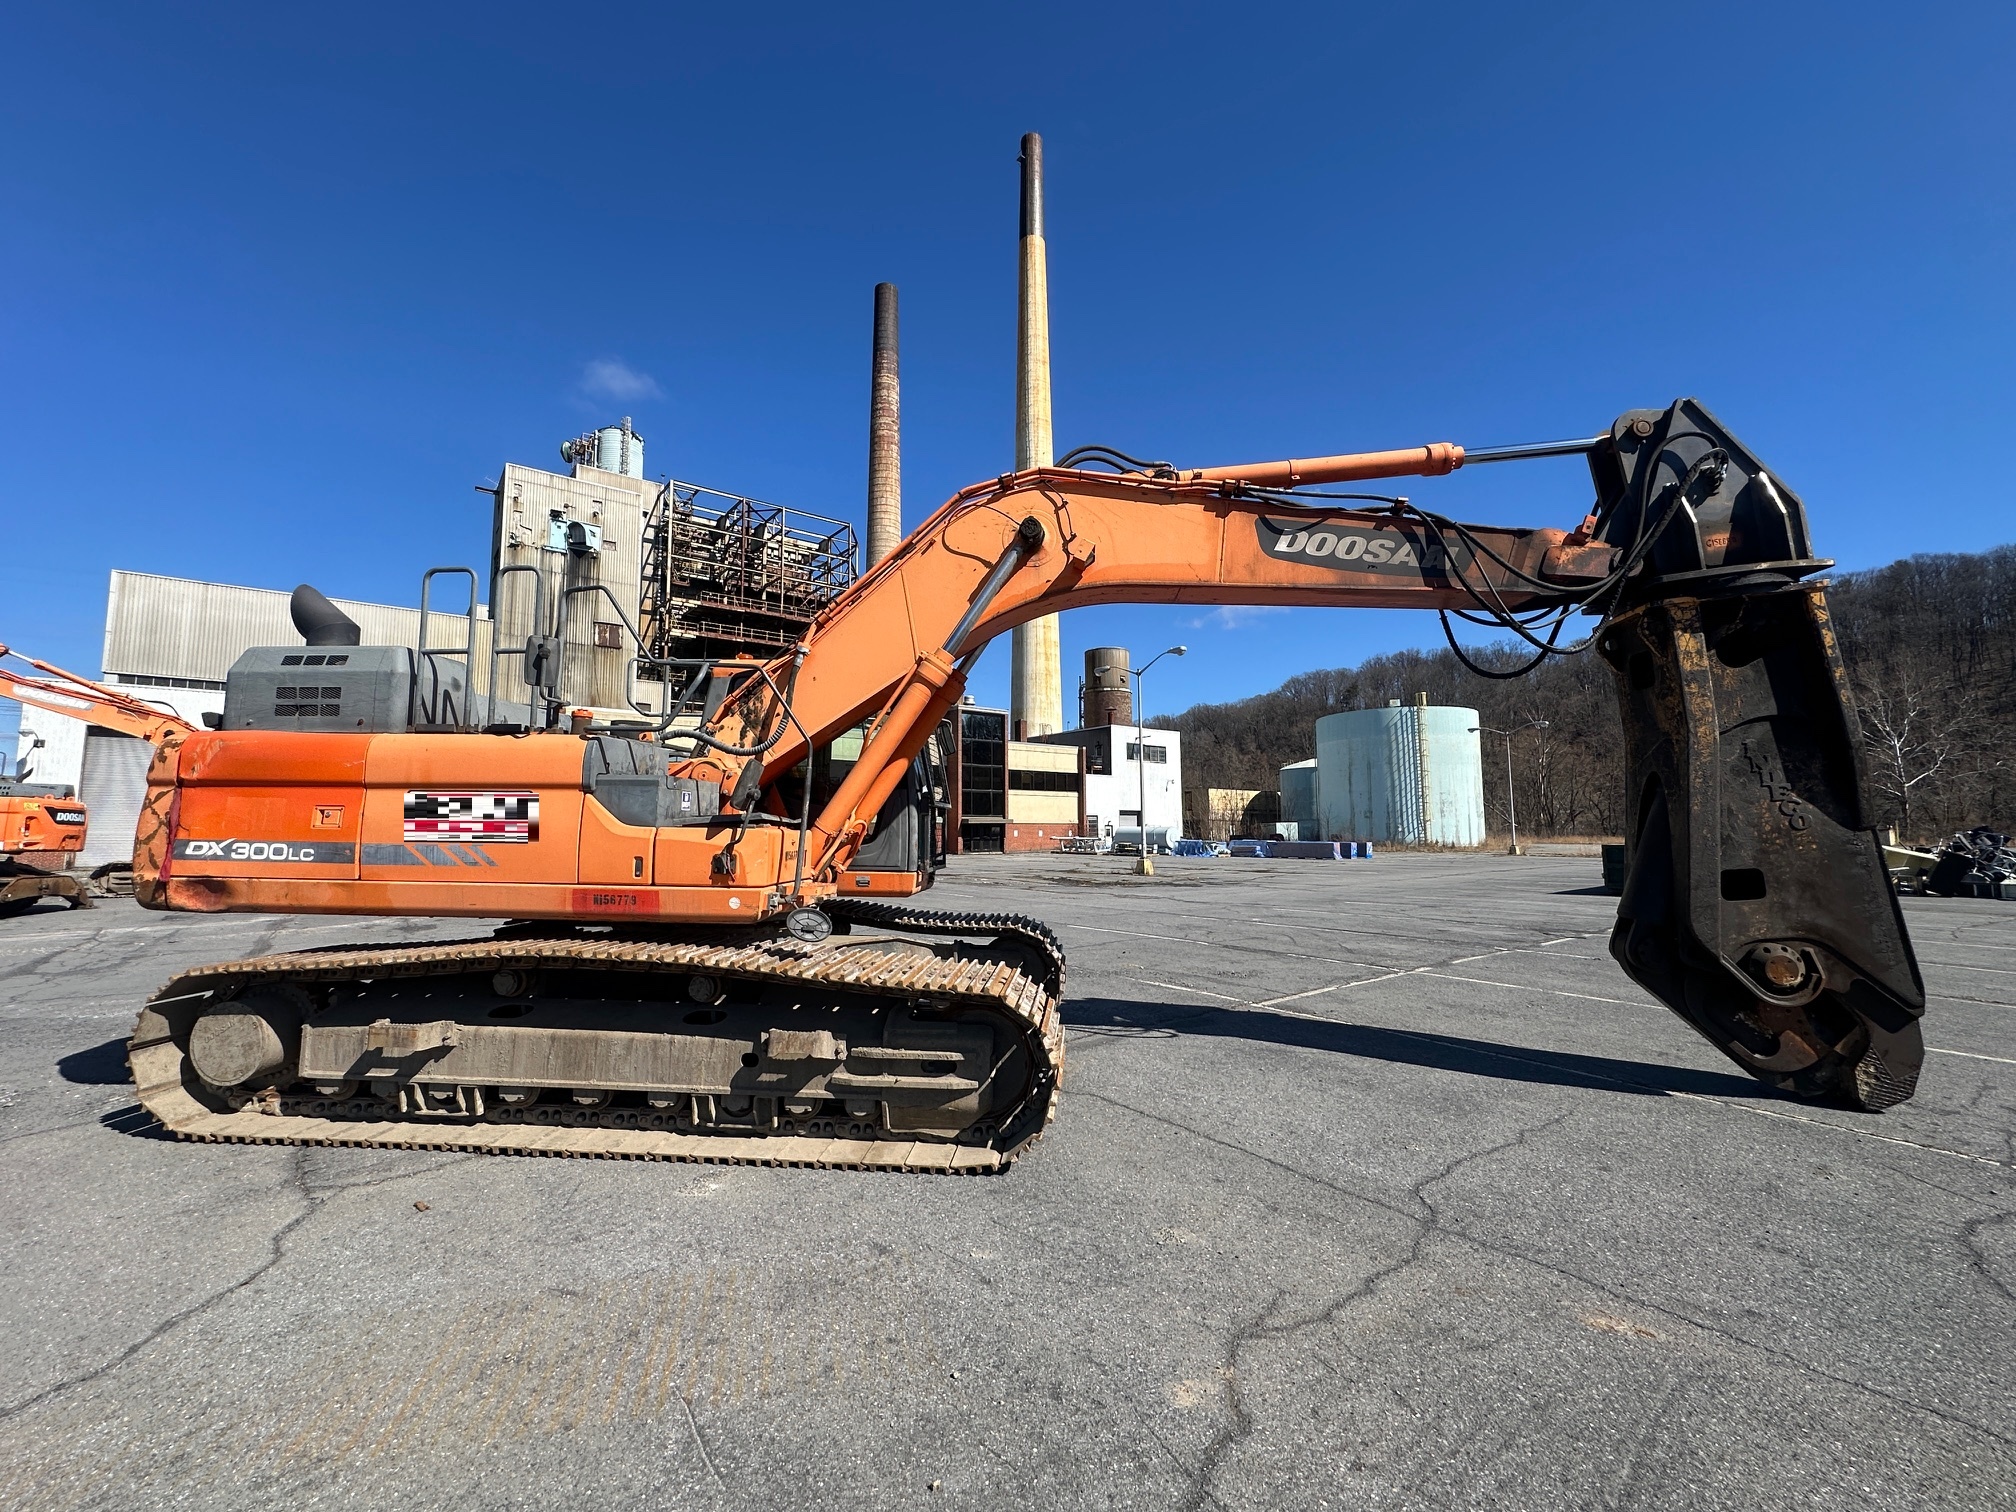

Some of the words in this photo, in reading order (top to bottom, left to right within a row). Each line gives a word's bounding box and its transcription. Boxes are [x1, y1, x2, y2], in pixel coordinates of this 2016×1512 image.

[1273, 528, 1460, 571] DOOSAN
[1741, 738, 1813, 831] INDECO
[184, 837, 237, 857] DX
[230, 842, 315, 862] 300LC
